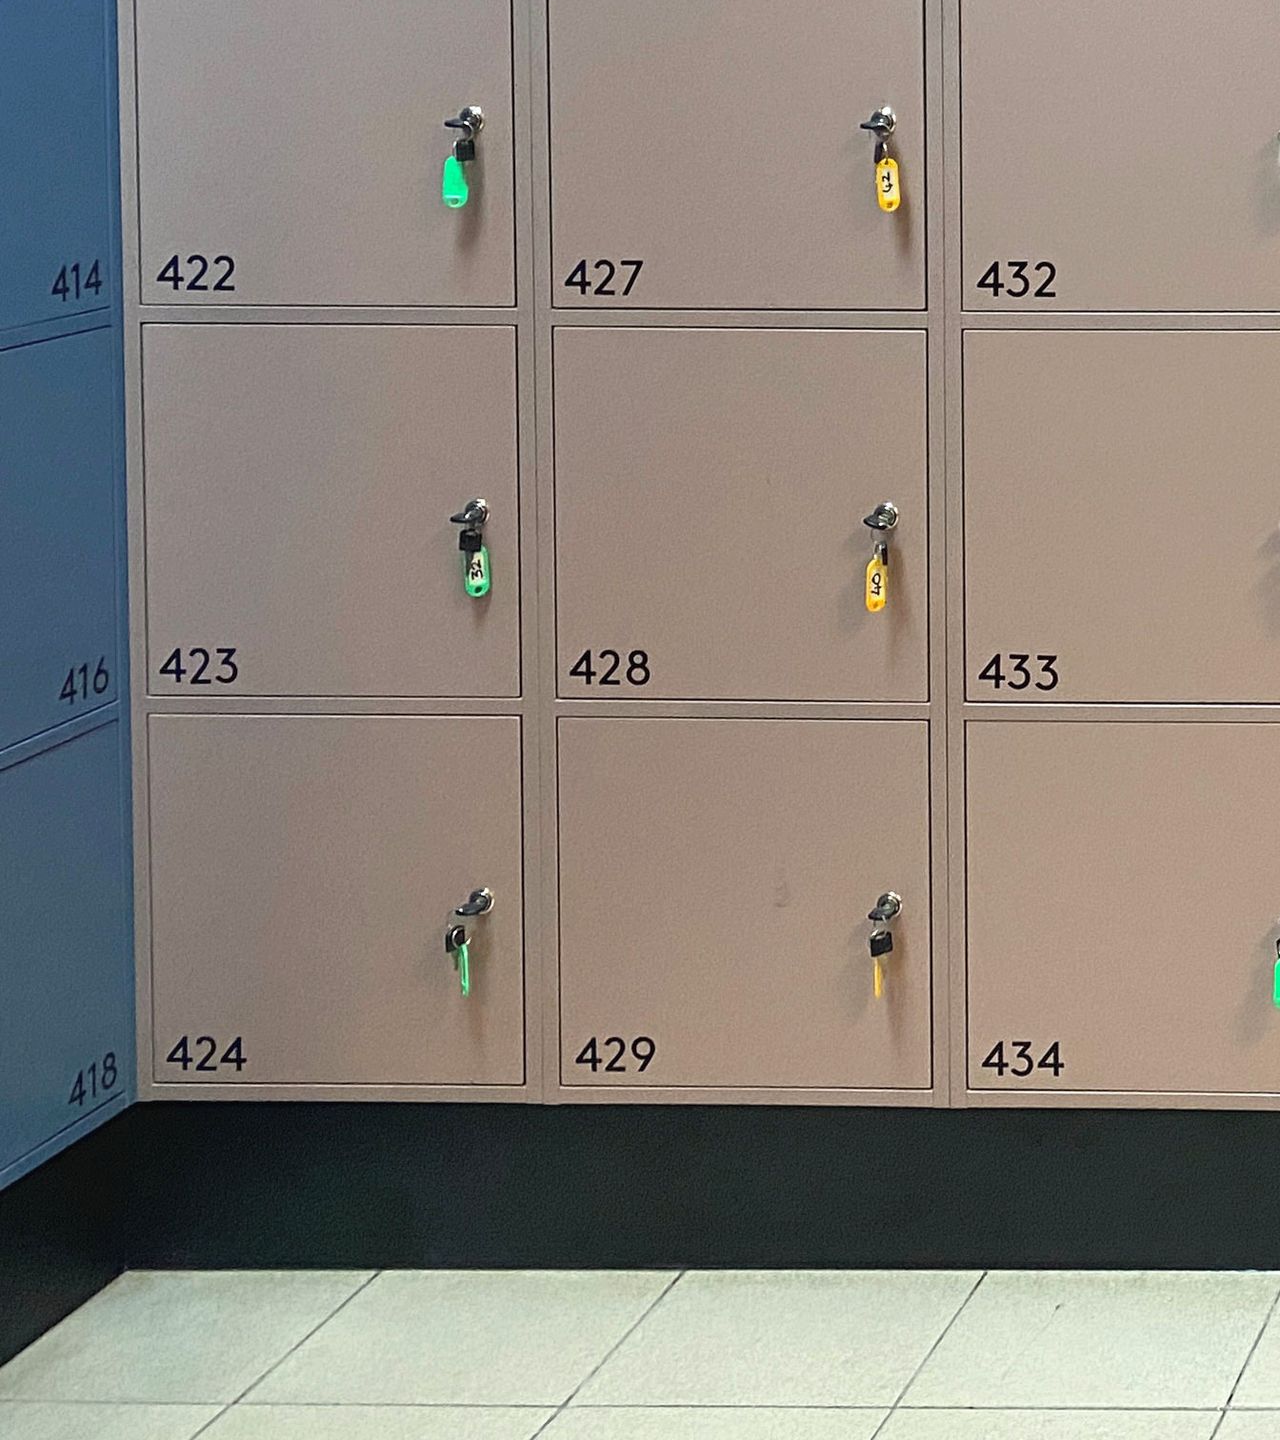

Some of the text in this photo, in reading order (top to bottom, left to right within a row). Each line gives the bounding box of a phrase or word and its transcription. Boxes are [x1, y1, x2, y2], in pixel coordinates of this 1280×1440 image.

[51, 258, 103, 302] 414
[156, 254, 236, 292] 422
[564, 259, 644, 297] 427
[976, 260, 1057, 298] 432
[471, 558, 483, 581] 32
[58, 656, 109, 706] 416
[159, 647, 239, 685] 423
[569, 649, 651, 686] 428
[978, 653, 1059, 691] 433
[166, 1035, 248, 1072] 424
[575, 1036, 656, 1073] 429
[981, 1040, 1065, 1078] 434
[67, 1051, 118, 1107] 418
